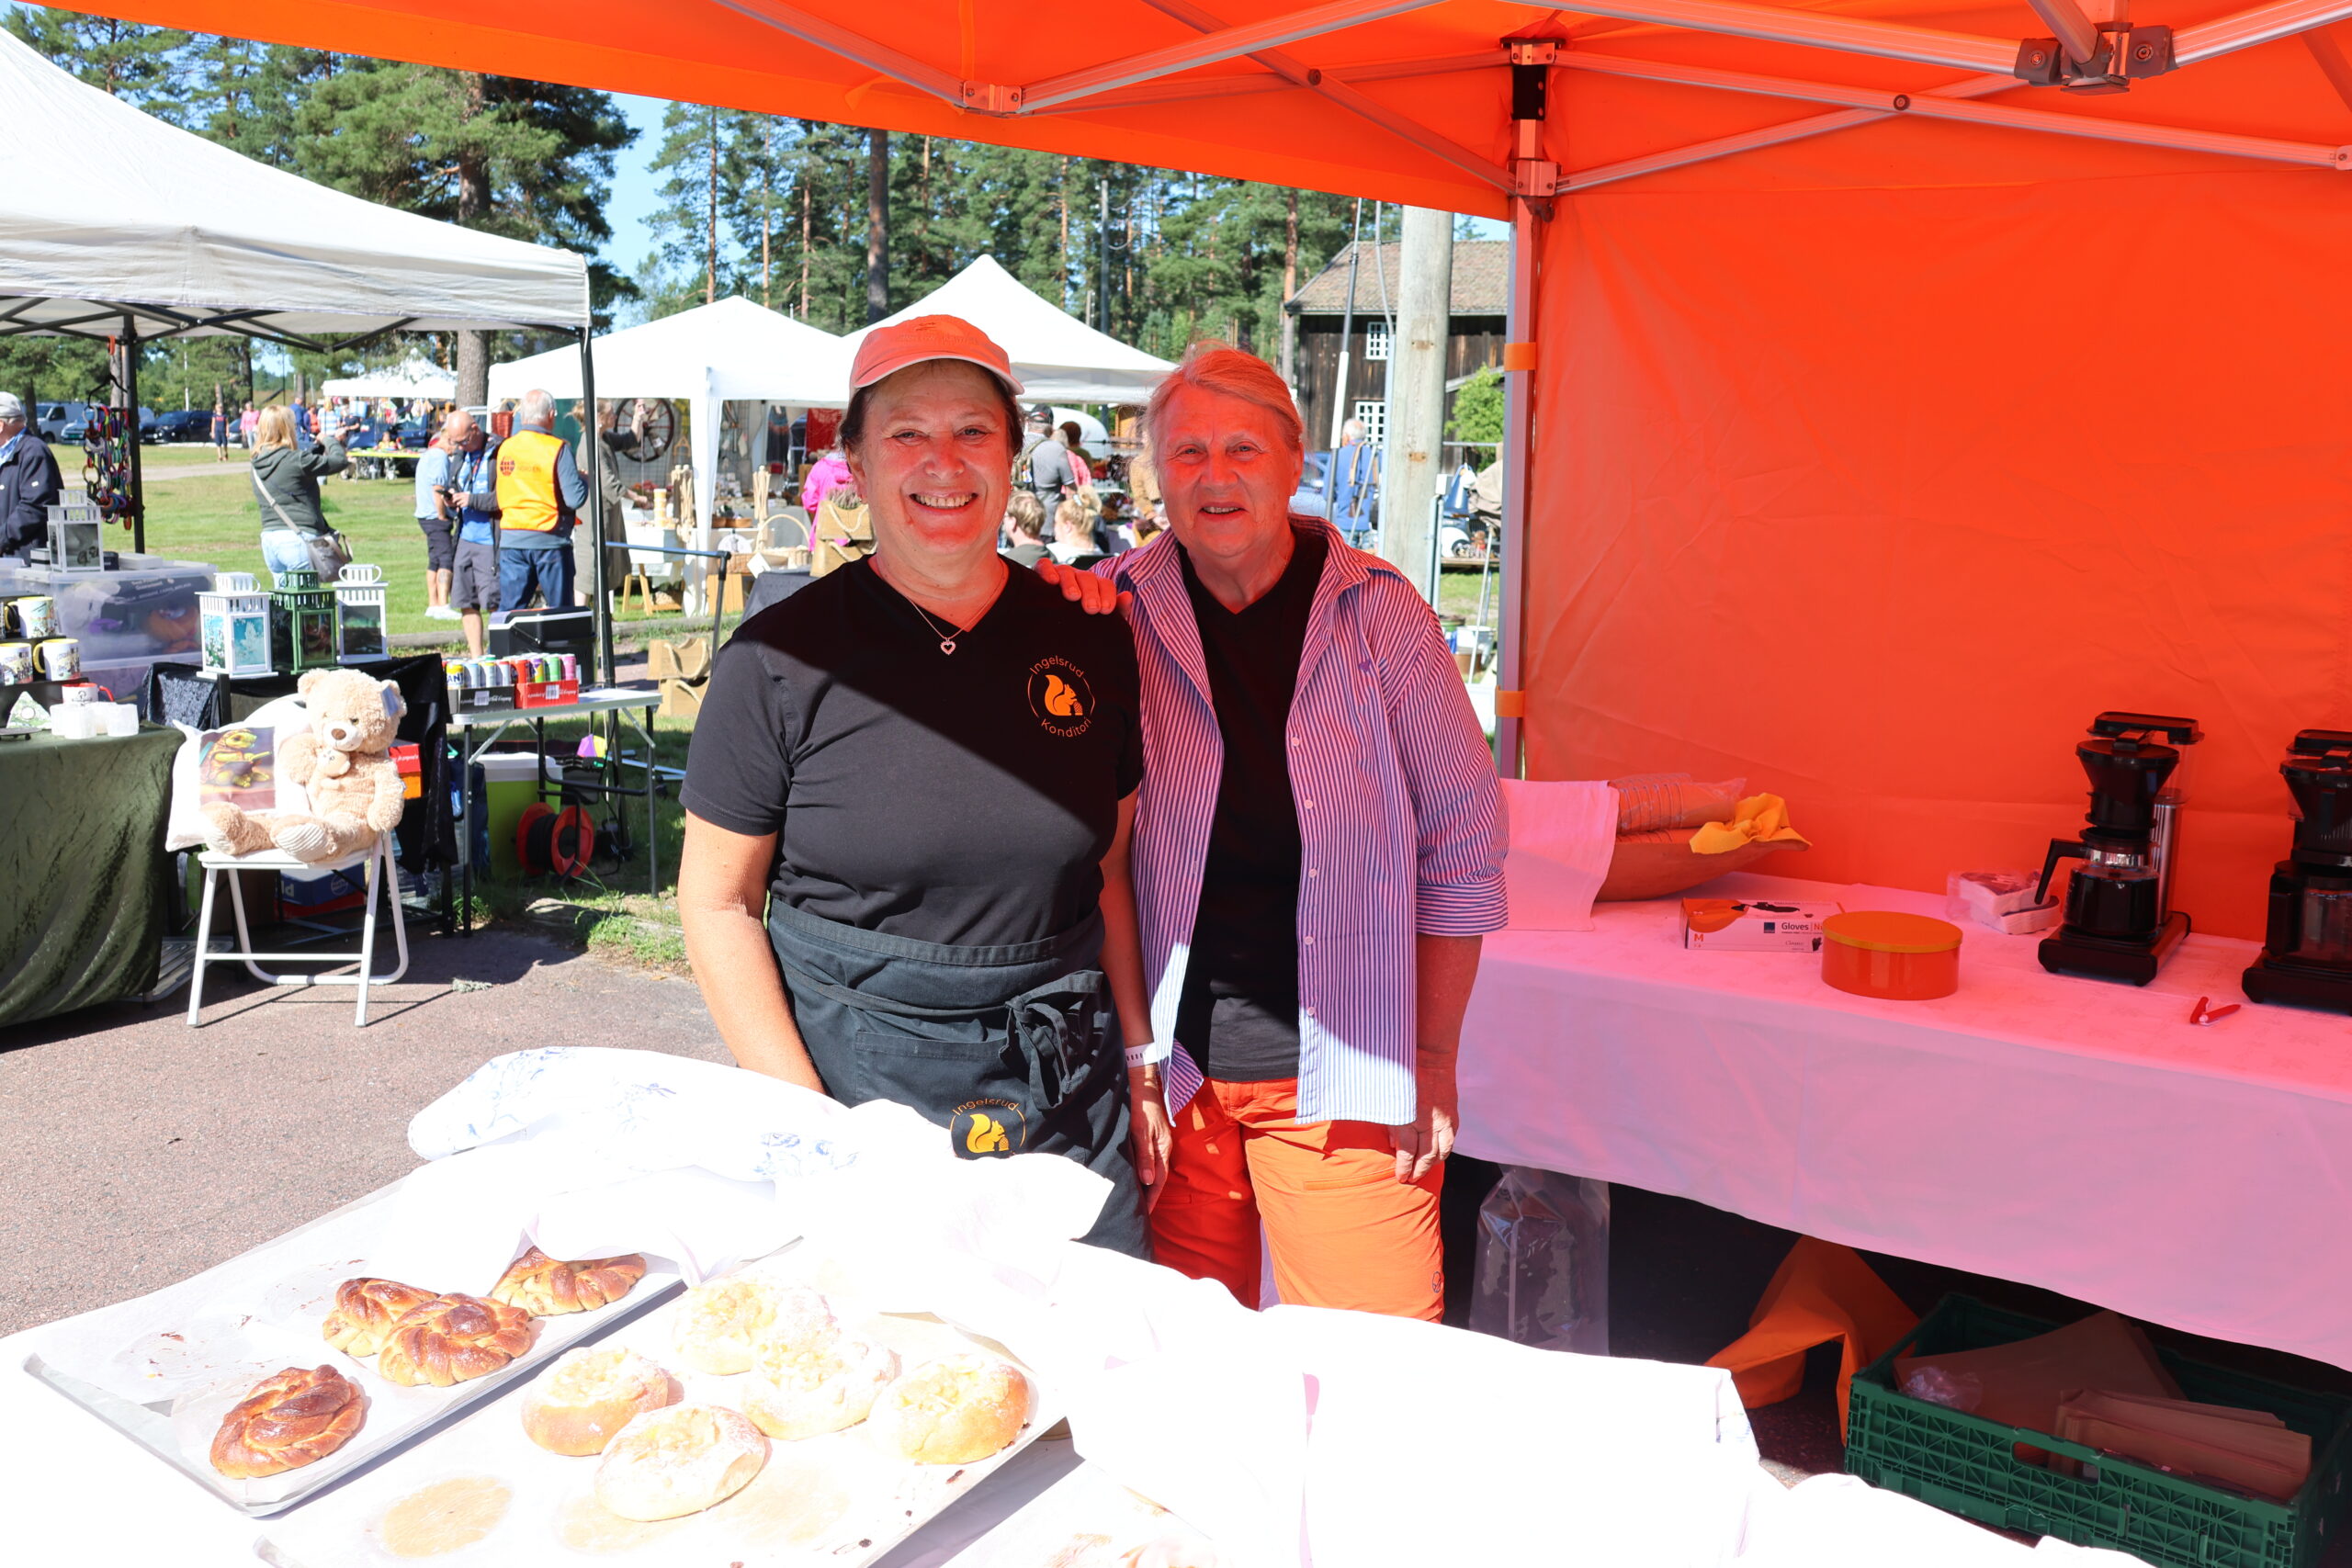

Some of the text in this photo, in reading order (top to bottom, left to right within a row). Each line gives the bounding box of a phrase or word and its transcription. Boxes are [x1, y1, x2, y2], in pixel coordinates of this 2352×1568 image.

[1029, 655, 1084, 678] Ingelsrud
[1041, 716, 1091, 738] Konditori
[1781, 921, 1809, 931] Gloves
[1693, 933, 1704, 942] M
[951, 1098, 1019, 1116] Ingelsrud
